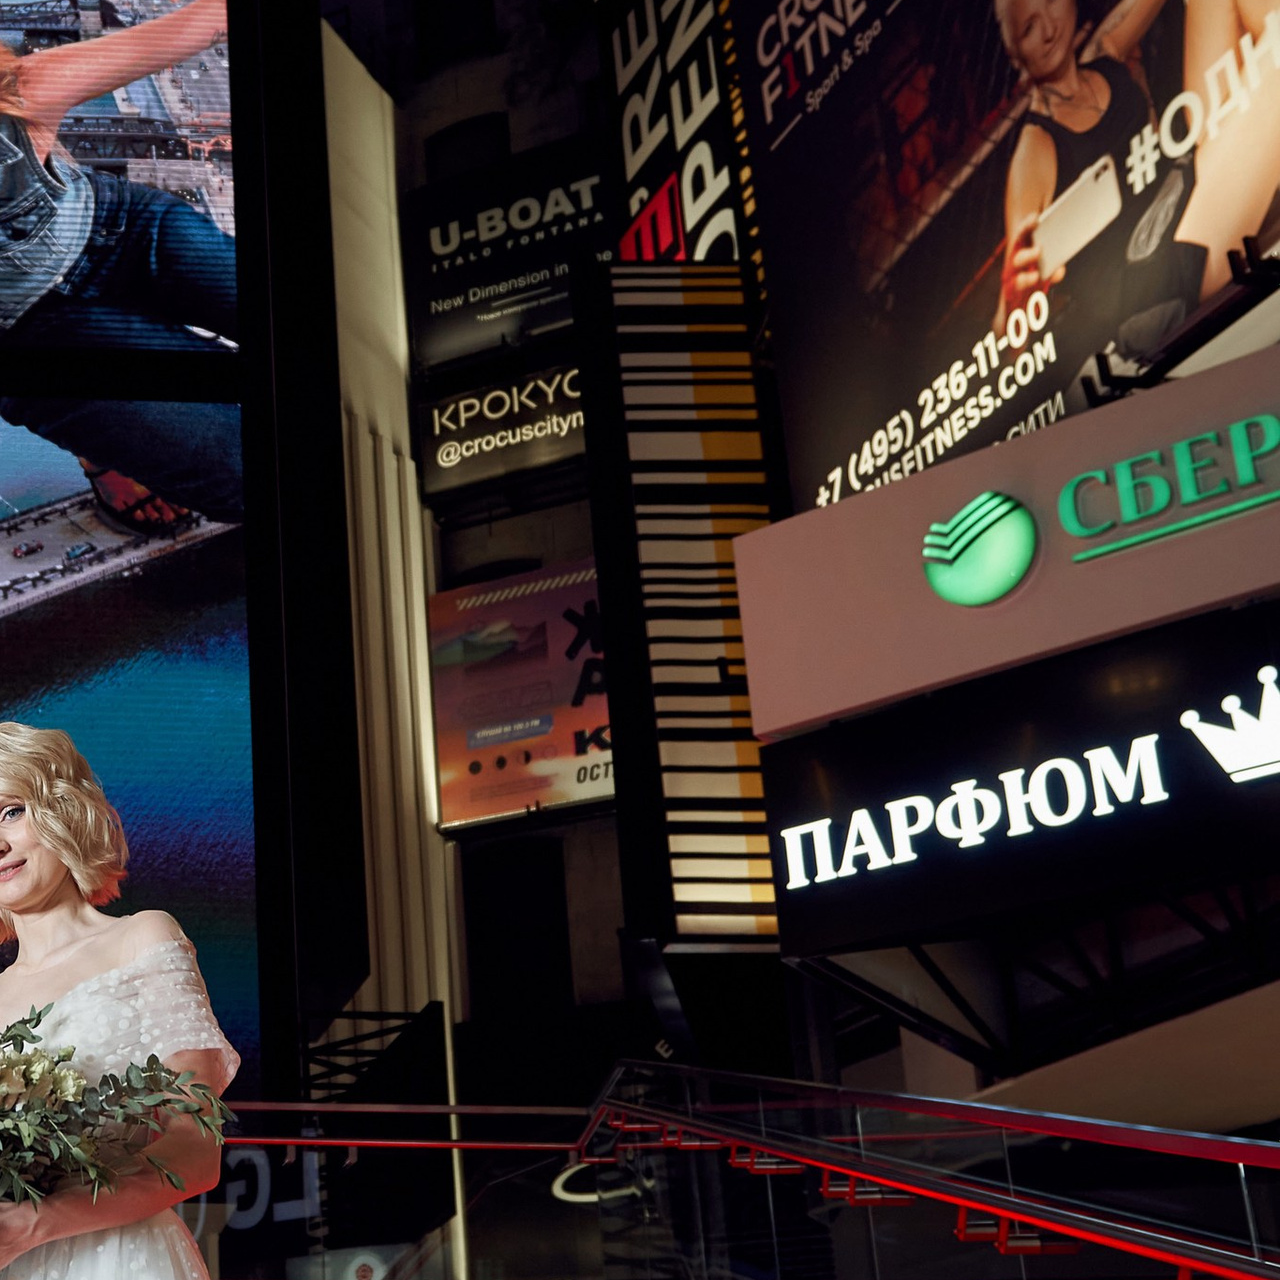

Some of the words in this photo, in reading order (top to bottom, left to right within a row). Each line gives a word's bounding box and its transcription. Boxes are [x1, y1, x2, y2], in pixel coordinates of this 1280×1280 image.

[804, 63, 841, 114] Sport
[841, 47, 855, 73] &
[853, 18, 883, 58] Spa
[430, 175, 601, 256] U-BOAT
[431, 246, 493, 274] ITALO
[506, 211, 605, 250] FONTANA
[430, 290, 465, 315] New
[469, 265, 552, 304] Dimension
[554, 261, 569, 282] in
[847, 411, 914, 491] (495)
[917, 290, 1050, 429] 236-11-00
[781, 733, 1169, 890] ПАРФЮМ
